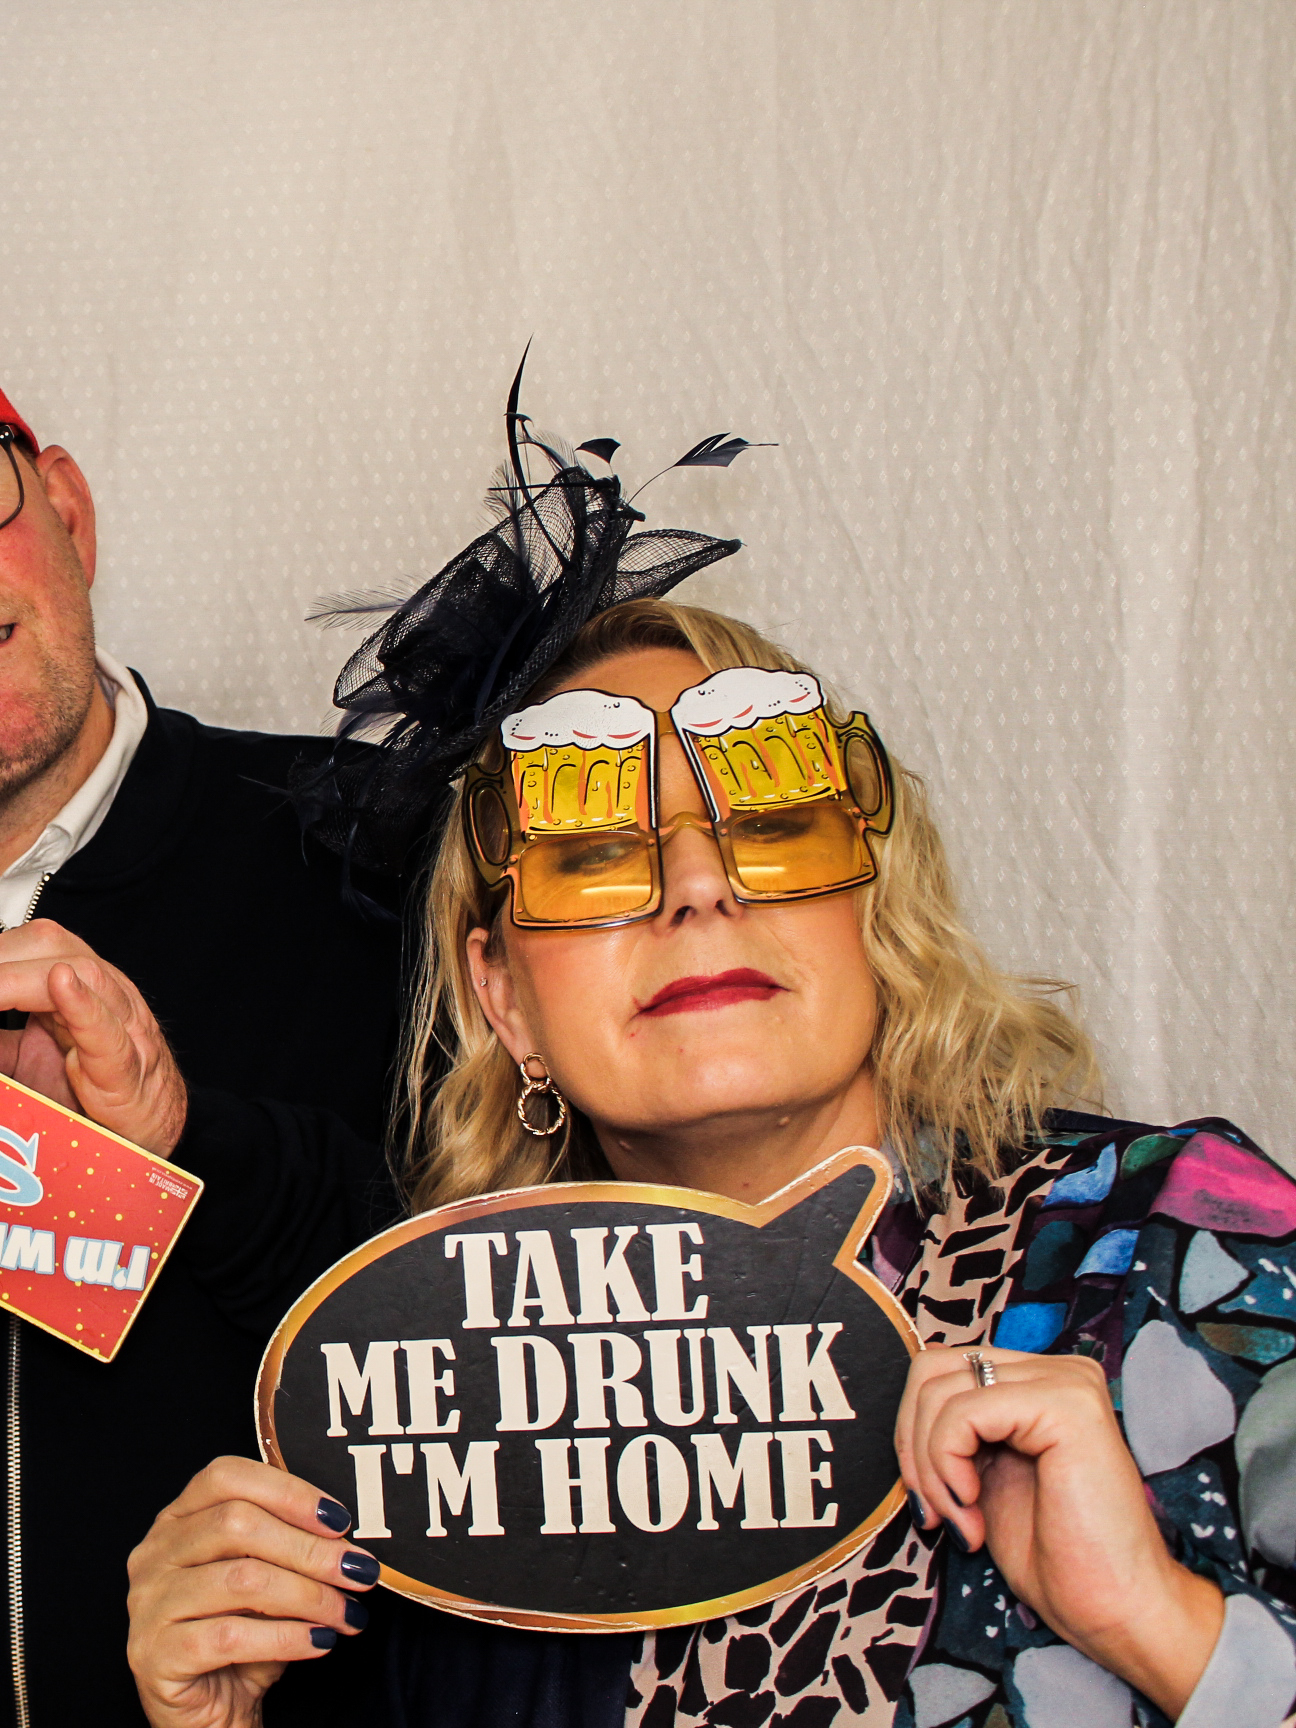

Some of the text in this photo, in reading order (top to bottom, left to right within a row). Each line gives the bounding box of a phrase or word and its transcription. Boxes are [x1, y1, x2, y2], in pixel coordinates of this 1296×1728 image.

[445, 1222, 709, 1329] TAKE
[320, 1322, 856, 1437] ME DRUNK
[347, 1430, 838, 1539] I'M HOME
